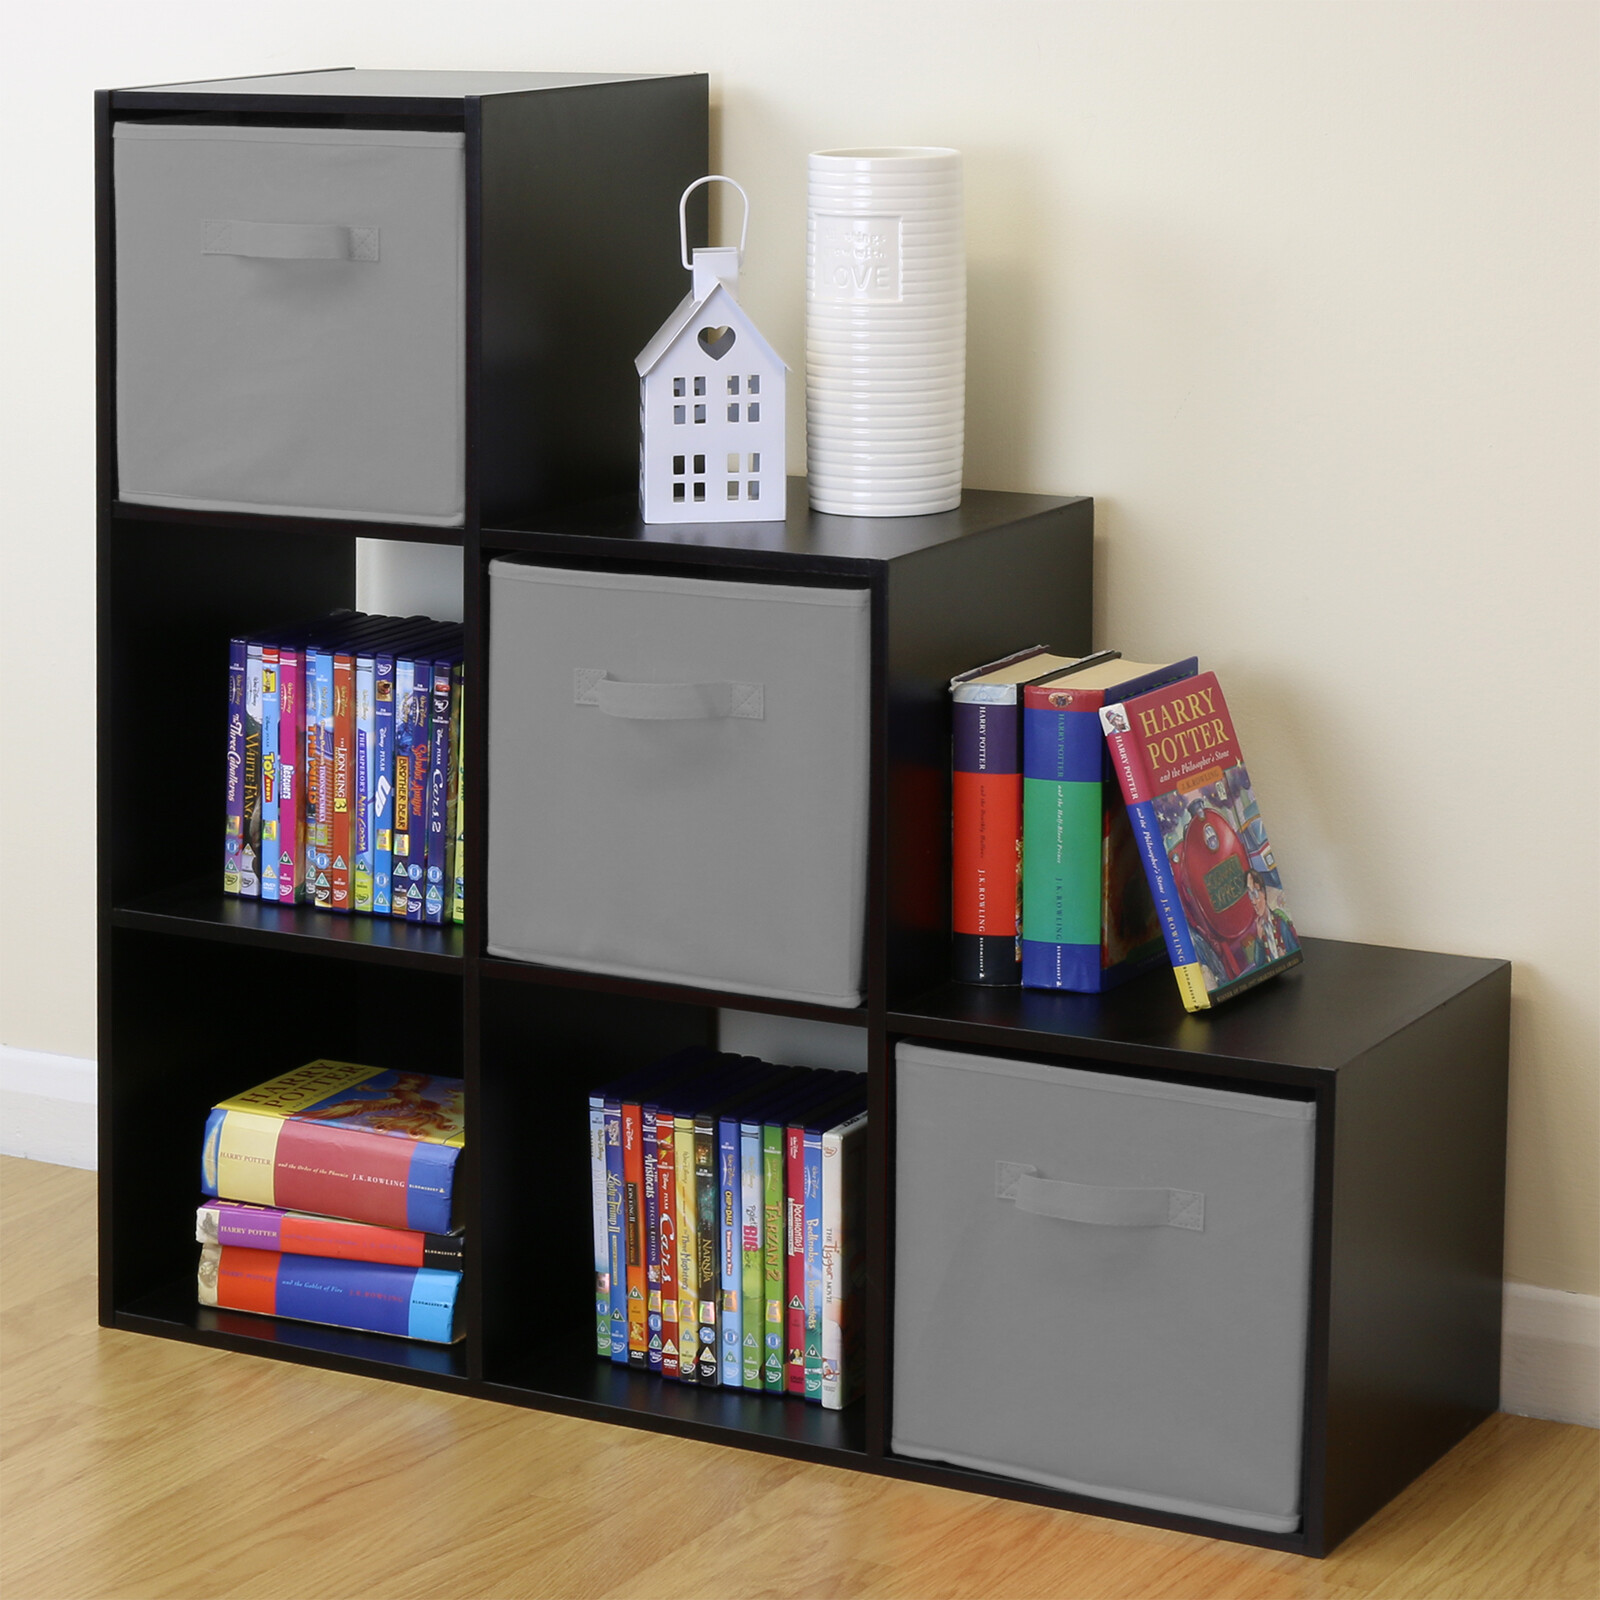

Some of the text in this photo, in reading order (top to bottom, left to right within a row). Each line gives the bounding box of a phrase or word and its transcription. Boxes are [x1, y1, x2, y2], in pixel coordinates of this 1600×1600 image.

[1138, 687, 1216, 738] HARRY
[229, 722, 243, 751] Three
[245, 732, 260, 782] WHITE
[1147, 718, 1230, 770] POTTER
[227, 750, 241, 802] Caballeros
[262, 752, 275, 780] TOY
[338, 747, 348, 771] LION
[1115, 735, 1139, 800] HARRY POTTER
[1160, 750, 1229, 783] and the Philosopher's Stone
[338, 772, 347, 798] KING
[374, 775, 392, 817] UP
[398, 758, 407, 828] BROTHER BEAR
[431, 768, 444, 833] Cars 2
[1056, 809, 1064, 843] Half-Blood
[978, 869, 986, 932] J.K.ROWLING
[1160, 899, 1186, 963] J.K.ROWLING
[240, 1062, 334, 1105] HARRY
[263, 1064, 367, 1109] POTTER
[220, 1151, 272, 1165] HARRY POTTER
[328, 1170, 349, 1179] Phoenix
[645, 1153, 658, 1199] Aristocats
[352, 1173, 406, 1188] J.K.ROWLING
[408, 1183, 439, 1192] BLOOMSBURY
[607, 1170, 622, 1196] Lady
[607, 1193, 622, 1226] Tramp
[725, 1190, 734, 1226] CHIP DALE
[793, 1203, 805, 1247] POCAHONTAS
[220, 1225, 278, 1238] HARRY POTTER
[660, 1213, 675, 1284] Cars
[743, 1225, 759, 1253] BIG
[765, 1201, 782, 1266] TARZAN
[806, 1218, 820, 1263] Bedknobs
[702, 1238, 714, 1283] NARNIA
[766, 1269, 781, 1282] 2
[822, 1240, 840, 1280] Tigger
[303, 1281, 323, 1290] Goblet
[323, 1285, 331, 1293] of
[330, 1286, 343, 1294] Fire
[807, 1279, 820, 1329] Broomsticks
[825, 1281, 833, 1304] MOVIE
